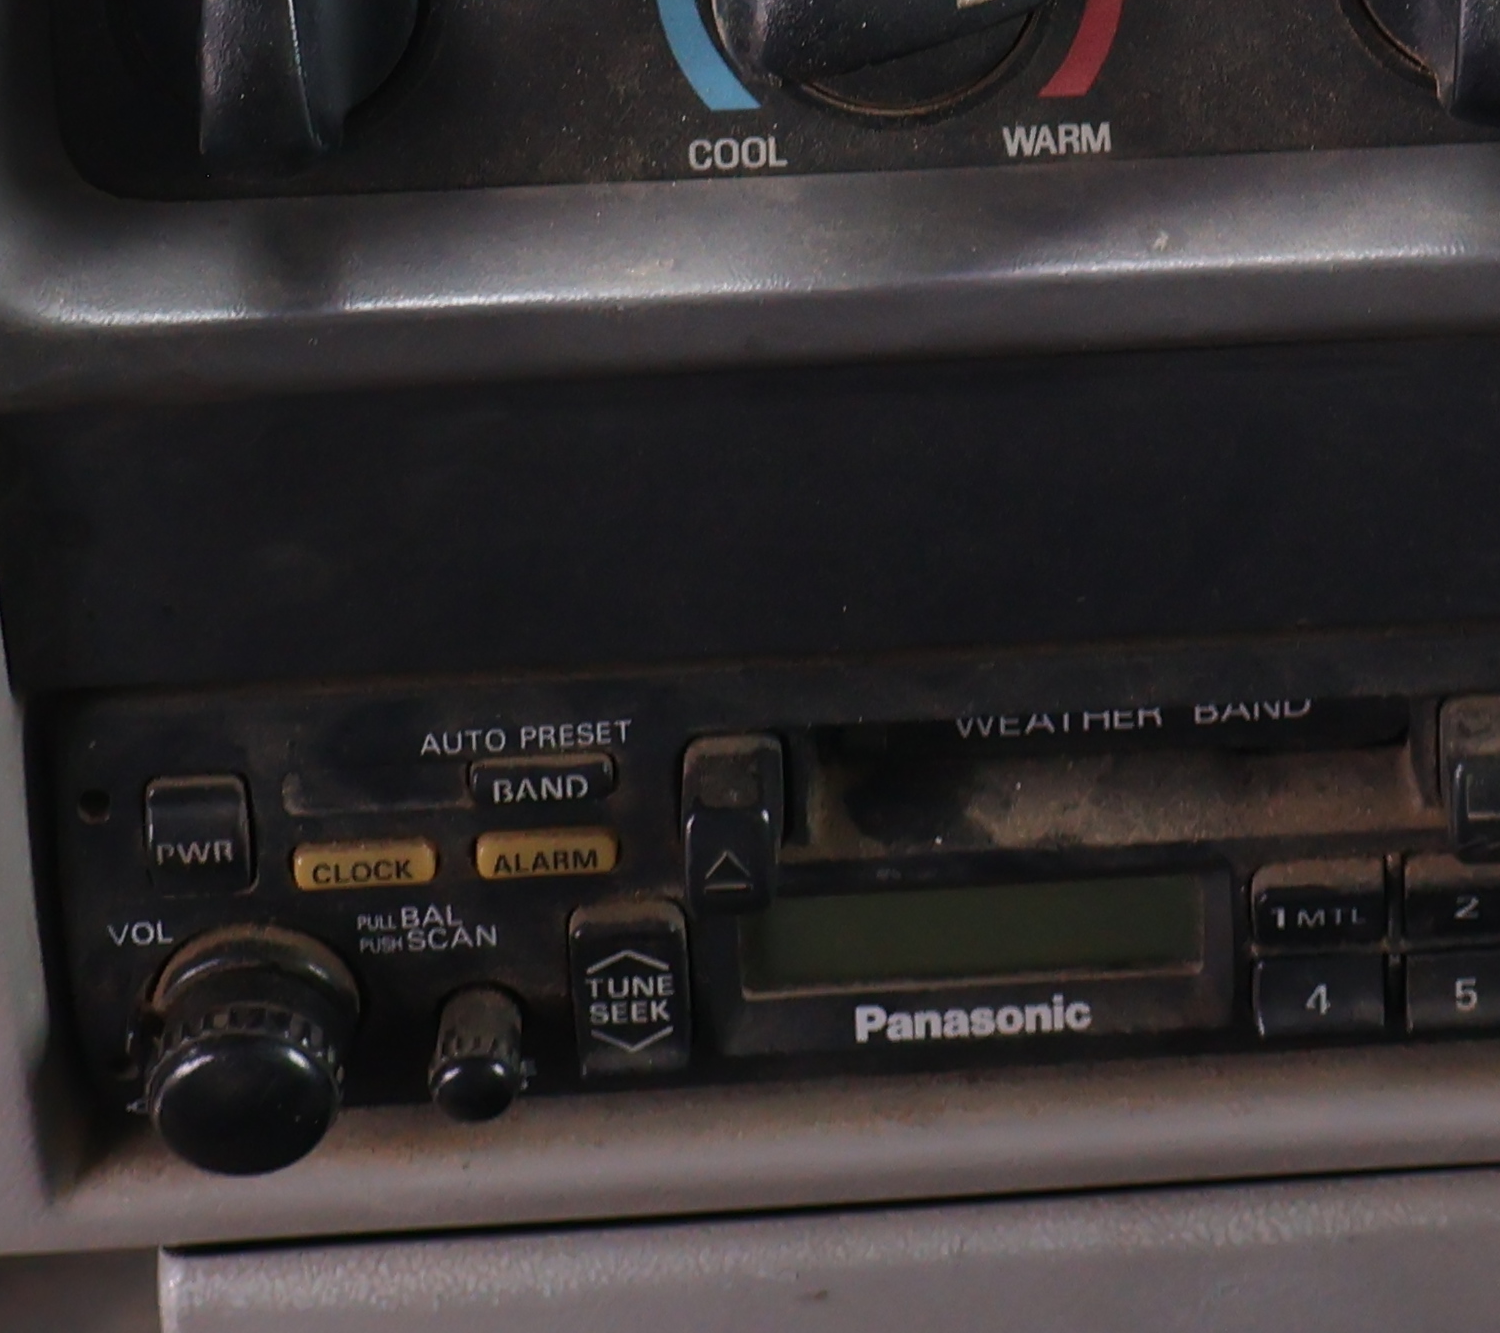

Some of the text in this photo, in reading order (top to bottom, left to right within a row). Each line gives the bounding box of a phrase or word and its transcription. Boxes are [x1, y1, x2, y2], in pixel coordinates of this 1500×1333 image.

[1002, 122, 1112, 157] WARM
[688, 137, 788, 172] COOL
[420, 719, 632, 756] AUTO PRESET
[493, 774, 588, 802] BAND
[156, 839, 234, 866] PWR
[492, 847, 599, 876] ALARM
[311, 858, 414, 885] CLOCK
[357, 902, 463, 931] PULL BAL
[1455, 896, 1480, 919] 2
[107, 921, 174, 947] VOL
[359, 924, 497, 954] PUSH SCAN
[585, 974, 674, 999] TUNE
[1305, 985, 1331, 1015] 4
[1454, 978, 1477, 1011] 5
[589, 999, 670, 1024] SEEK
[854, 994, 1092, 1043] Panasonic
